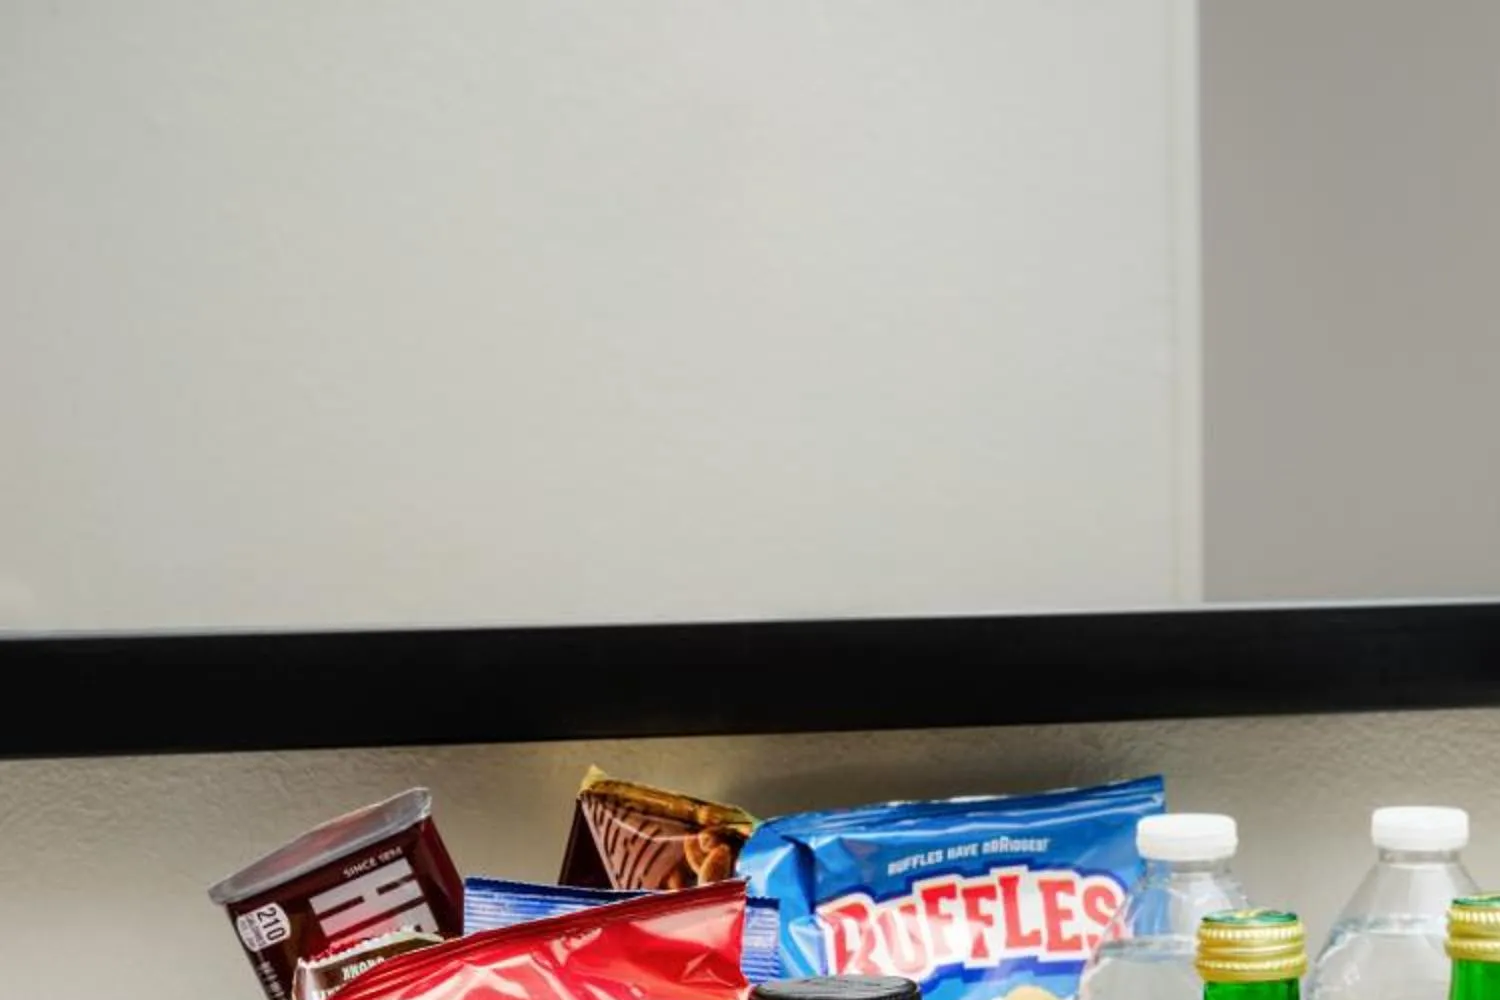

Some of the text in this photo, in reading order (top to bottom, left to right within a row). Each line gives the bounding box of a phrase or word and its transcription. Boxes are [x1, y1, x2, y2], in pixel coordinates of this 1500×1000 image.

[948, 842, 979, 860] HAVE
[343, 857, 378, 879] SINCE
[256, 906, 286, 941] 210
[822, 873, 1123, 976] RUFFLES
